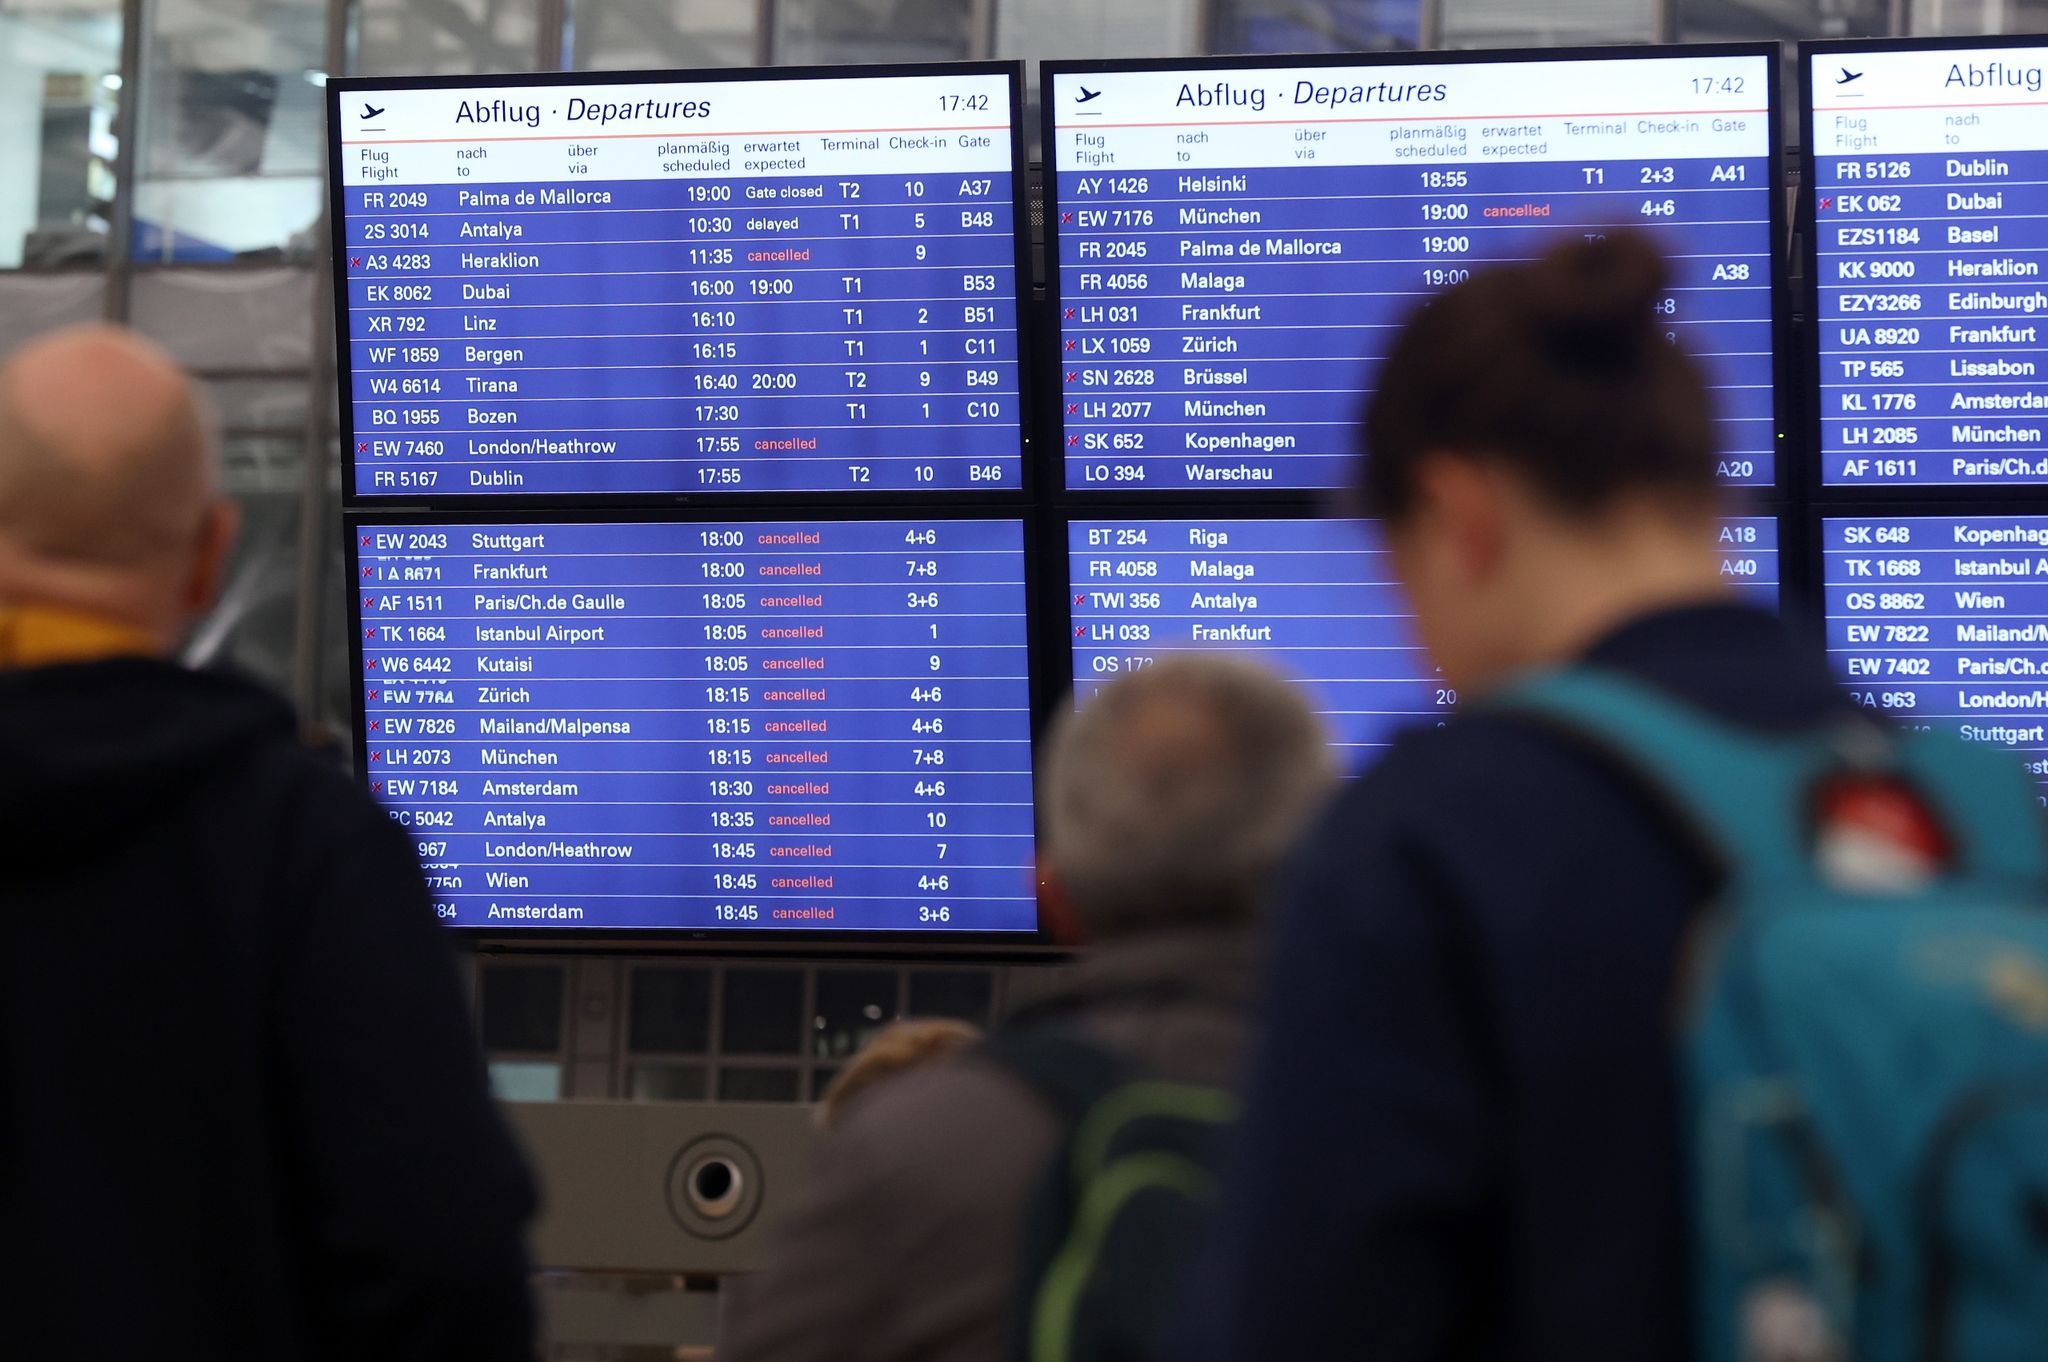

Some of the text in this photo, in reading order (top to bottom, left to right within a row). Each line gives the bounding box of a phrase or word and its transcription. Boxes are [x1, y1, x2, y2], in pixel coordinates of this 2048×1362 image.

[1691, 77, 1745, 94] 17:42
[1944, 62, 2042, 92] Abflug
[939, 94, 989, 112] 17:42
[1175, 80, 1447, 112] Abflug Departures
[455, 97, 711, 128] Abflug Departures
[1835, 112, 1980, 131] Flug nach
[1075, 118, 1746, 148] Flug nach über planmäßig erwartet Terminal Check-in Gate
[1835, 133, 1960, 150] Flight to
[361, 134, 991, 163] Flug nach über planmäßig erwartet Terminal Check-in Gate
[1075, 142, 1547, 167] Flight to via scheduled expected
[361, 156, 806, 181] Flight to via scheduled expected
[1837, 160, 2008, 179] FR 5126 Dublin
[1077, 165, 1745, 194] AY 1426 Helsinki 18:55 T1 2+3 A41
[364, 180, 992, 208] FR 2049 Palma de Mallorca 19:00 Gate closed T2 10 A37
[1078, 200, 1675, 227] EW 7176 München 19:00 cancelled 4+6
[364, 211, 993, 240] 2S 3014 Antalya 10:30 delayed T1 5 B48
[1838, 226, 1998, 246] EZS1184 Basel
[1080, 264, 1750, 292] FR 4056 Malaga 19:00 A38
[1081, 306, 1104, 322] LH
[1108, 306, 1137, 322] 031
[1182, 304, 1261, 320] Frankfurt
[1840, 325, 2036, 345] UA 8920 Frankfurt
[368, 338, 995, 365] WF 1859 Bergen 16:15 T1 1 C11
[1082, 368, 1247, 386] SN 2628 Brüssel
[1084, 432, 1295, 452] SK 652 Kopenhagen
[1842, 425, 2041, 444] LH 2085 München
[373, 436, 816, 456] EW 7460 London/Heathrow 17:55 cancelled
[1086, 460, 1754, 481] LO 394 Warschau A20
[376, 529, 936, 552] EW 2043 Stuttgart 18:00 cancelled 4+6
[1089, 526, 1757, 548] BT 254 Riga A18
[1844, 558, 2030, 576] TK 1668 Istanbul
[379, 592, 938, 611] AF 1511 Paris/Ch.de Gaulle 18:05 cancelled 3+6
[1090, 592, 1257, 612] TWI 356 Antalya
[1846, 592, 2005, 610] OS 8862 Wien
[385, 718, 943, 737] EW 7826 Mailand/Malpensa 18:15 cancelled 4+6
[415, 811, 454, 826] 5042
[484, 810, 546, 830] Antalya
[711, 812, 754, 827] 18:35
[768, 813, 830, 826] cancelled
[927, 812, 946, 828] 10
[418, 842, 947, 859] 967 London/Heathrow 18:45 cancelled 7
